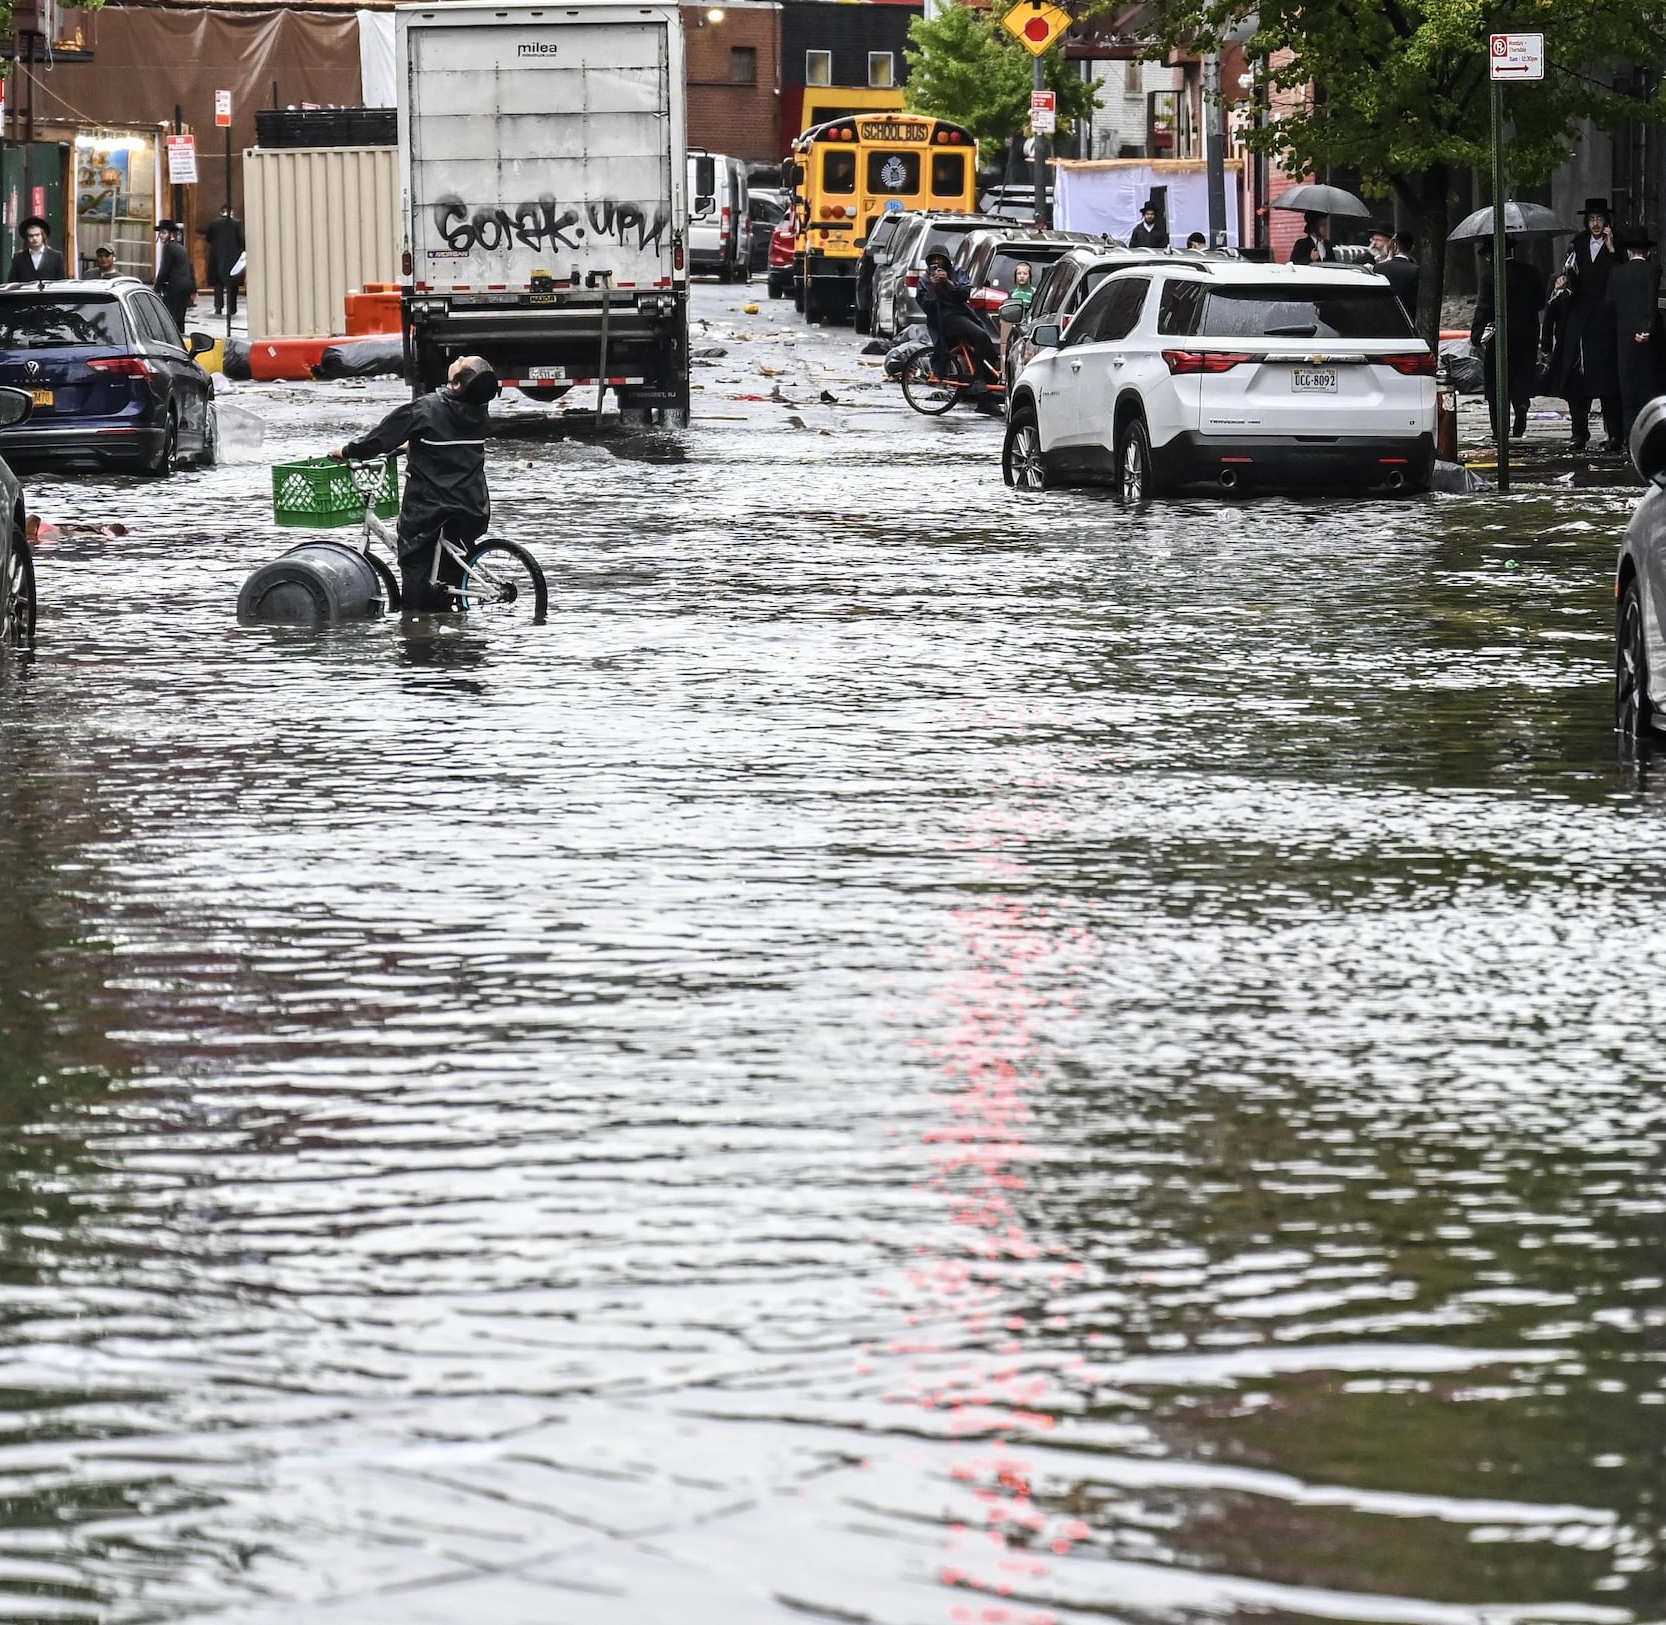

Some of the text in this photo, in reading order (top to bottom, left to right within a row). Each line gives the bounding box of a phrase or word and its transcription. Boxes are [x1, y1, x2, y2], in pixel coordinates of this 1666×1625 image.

[517, 42, 558, 57] milea
[862, 123, 927, 142] SCHOOL BUS
[1295, 375, 1336, 386] UCG-8092
